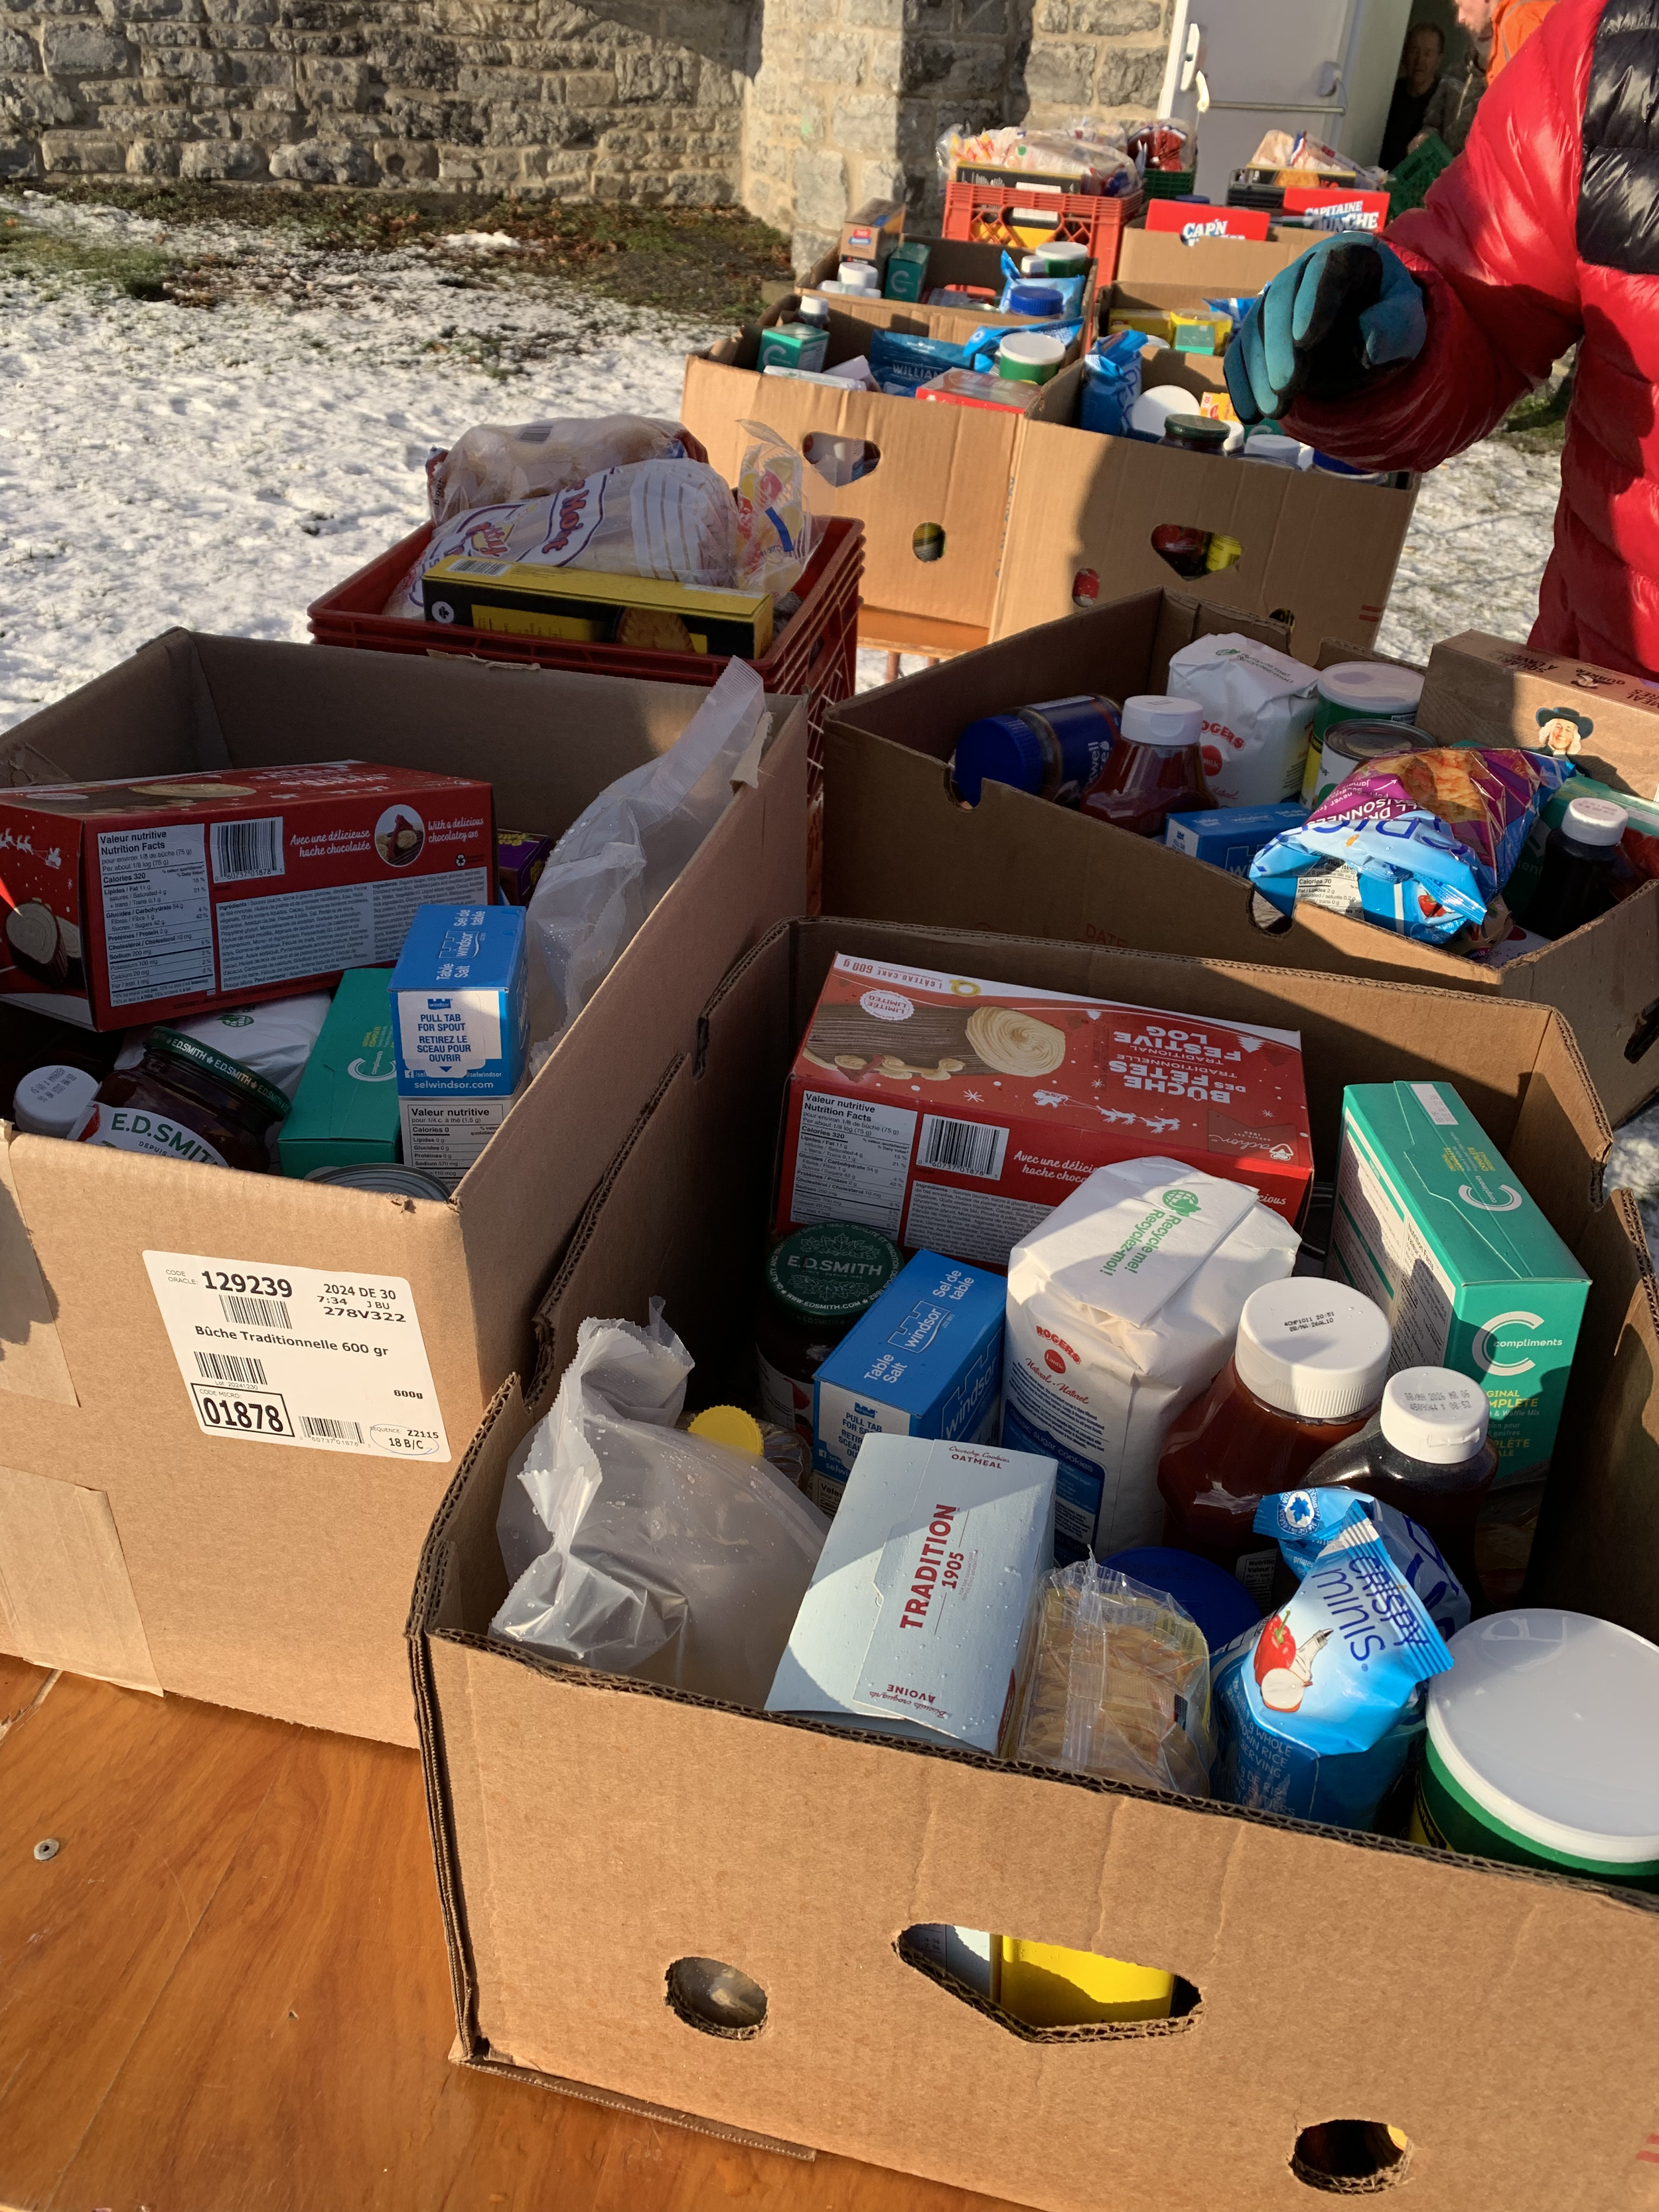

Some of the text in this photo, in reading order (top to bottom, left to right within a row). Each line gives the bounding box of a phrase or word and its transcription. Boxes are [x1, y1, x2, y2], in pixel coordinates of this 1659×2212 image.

[100, 830, 167, 846] Valeur nutritive
[332, 829, 371, 842] délicieuse
[102, 841, 165, 856] Nutrition Facts
[299, 840, 372, 857] hache chocolatée
[103, 872, 147, 885] Calories 320
[470, 910, 486, 926] table
[456, 932, 474, 958] windsor
[436, 963, 455, 981] Table
[454, 965, 470, 978] Salt
[429, 1000, 451, 1009] windsor
[868, 994, 907, 1009] LIMITED
[417, 1022, 466, 1032] FOR SPOUT
[420, 1013, 461, 1023] PULL TAB
[419, 1035, 468, 1045] RETIREZ LE
[1145, 1025, 1208, 1045] LOG
[417, 1044, 471, 1054] SCEAU POUR
[1113, 1030, 1242, 1063] FESTIVE
[1129, 1045, 1224, 1066] TRADITIONAL
[429, 1053, 461, 1063] OUVRIR
[1116, 1053, 1238, 1078] TRADITIONNELLE
[414, 1079, 494, 1090] selwindsor.com
[1108, 1059, 1246, 1093] DES FÊTES
[1123, 1074, 1231, 1104] BÛCHE
[411, 1108, 490, 1117] Valeur nutritive
[804, 1102, 872, 1123] Nutrition Facts
[805, 1093, 876, 1114] Valeur nutritive
[801, 1126, 831, 1138] Calories
[138, 1140, 167, 1157] DEPUIS
[1040, 1158, 1060, 1169] une
[1099, 1208, 1166, 1276] Recyclez-moi!
[1141, 1215, 1183, 1253] Recycle
[165, 1269, 186, 1278] CODE
[786, 1254, 883, 1276] E.D.SMITH
[168, 1276, 198, 1286] ORACLE:
[201, 1270, 293, 1298] 129239
[932, 1269, 962, 1299] Sel de
[948, 1277, 975, 1301] table
[323, 1284, 397, 1301] 2024 DE 30
[317, 1295, 390, 1310] 7:34 BU
[323, 1306, 407, 1323] 278V322
[904, 1307, 943, 1349] windsor
[194, 1325, 389, 1357] Bûche Traditionnelle 600 gr
[1035, 1325, 1082, 1365] ROGERS
[1494, 1337, 1563, 1349] compliments
[863, 1353, 895, 1382] Table
[883, 1362, 908, 1384] Salt
[1025, 1358, 1090, 1404] Natural Naturel
[1489, 1398, 1539, 1408] MPLETE
[202, 1397, 284, 1433] 01878
[845, 1412, 883, 1432] PULL TAB
[407, 1429, 439, 1439] Z2115
[842, 1419, 858, 1432] FOR
[389, 1437, 425, 1450] 18 B/C
[1033, 1430, 1057, 1452] sugar
[1057, 1447, 1095, 1473] cookies
[948, 1445, 1011, 1463] Crunchy Cookies
[950, 1453, 1002, 1469] OATMEAL
[899, 1503, 957, 1629] TRADITION
[941, 1552, 964, 1589] 1905
[1348, 1555, 1431, 1647] CRISPY
[1311, 1568, 1386, 1661] minis
[886, 1684, 937, 1705] AVOINE
[1256, 1726, 1293, 1758] WHOLE
[1261, 1746, 1289, 1768] RICE
